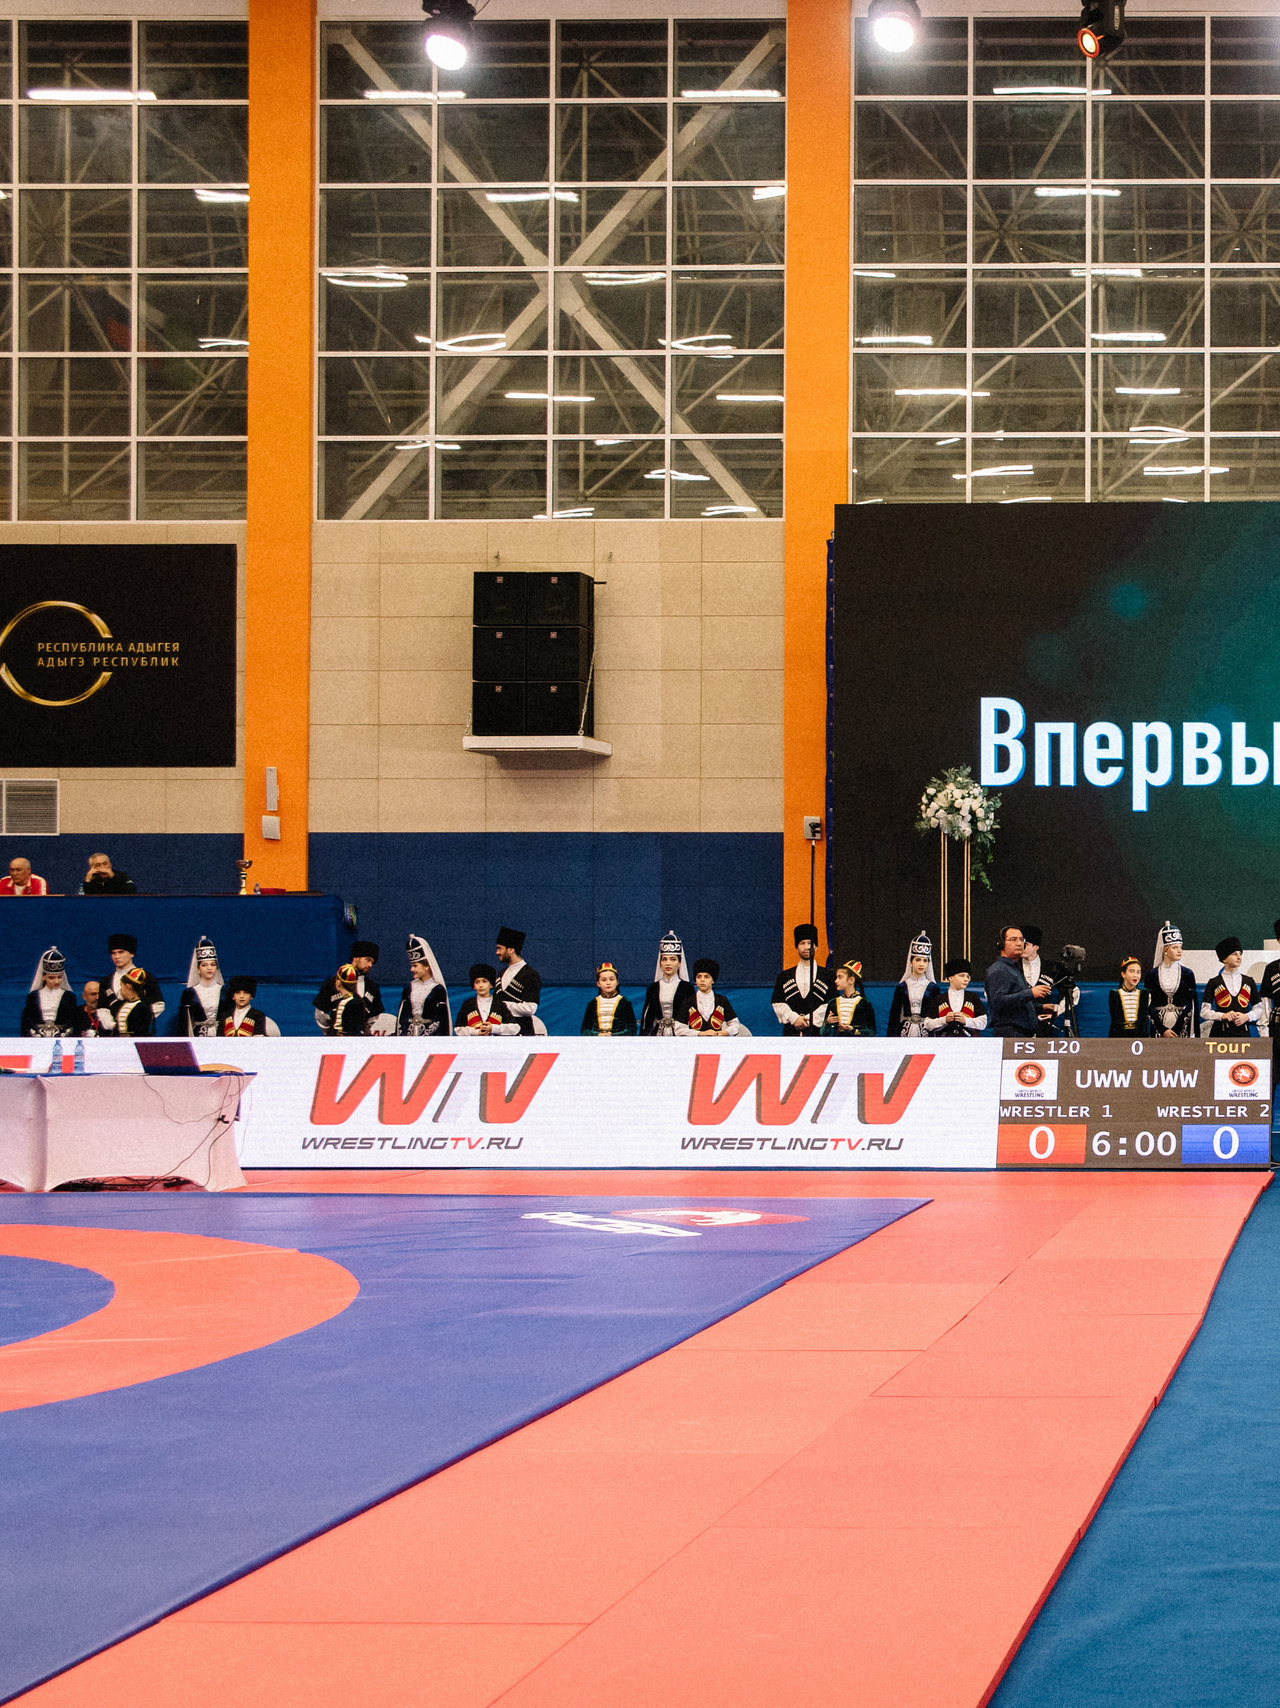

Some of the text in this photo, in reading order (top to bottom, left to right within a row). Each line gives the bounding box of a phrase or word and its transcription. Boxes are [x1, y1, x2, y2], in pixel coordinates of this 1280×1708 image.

[37, 642, 180, 654] РЕСПУБЛИКА АДЫГЕЯ
[37, 657, 179, 668] АДЫГЭ РЕСПУБЛИК
[1013, 1041, 1080, 1054] FS 120
[1131, 1041, 1144, 1055] 0
[1205, 1042, 1251, 1054] Tour
[1075, 1069, 1199, 1088] UWW UWW
[1000, 1105, 1113, 1118] WRESTLER 1
[1157, 1104, 1270, 1118] WRESTLER 2
[301, 1137, 524, 1150] WRESTLINGTV.RU
[680, 1137, 904, 1150] WRESTLINGTV.RU
[1028, 1126, 1055, 1159] 0
[1092, 1131, 1177, 1156] 6:00
[1213, 1126, 1240, 1159] 0
